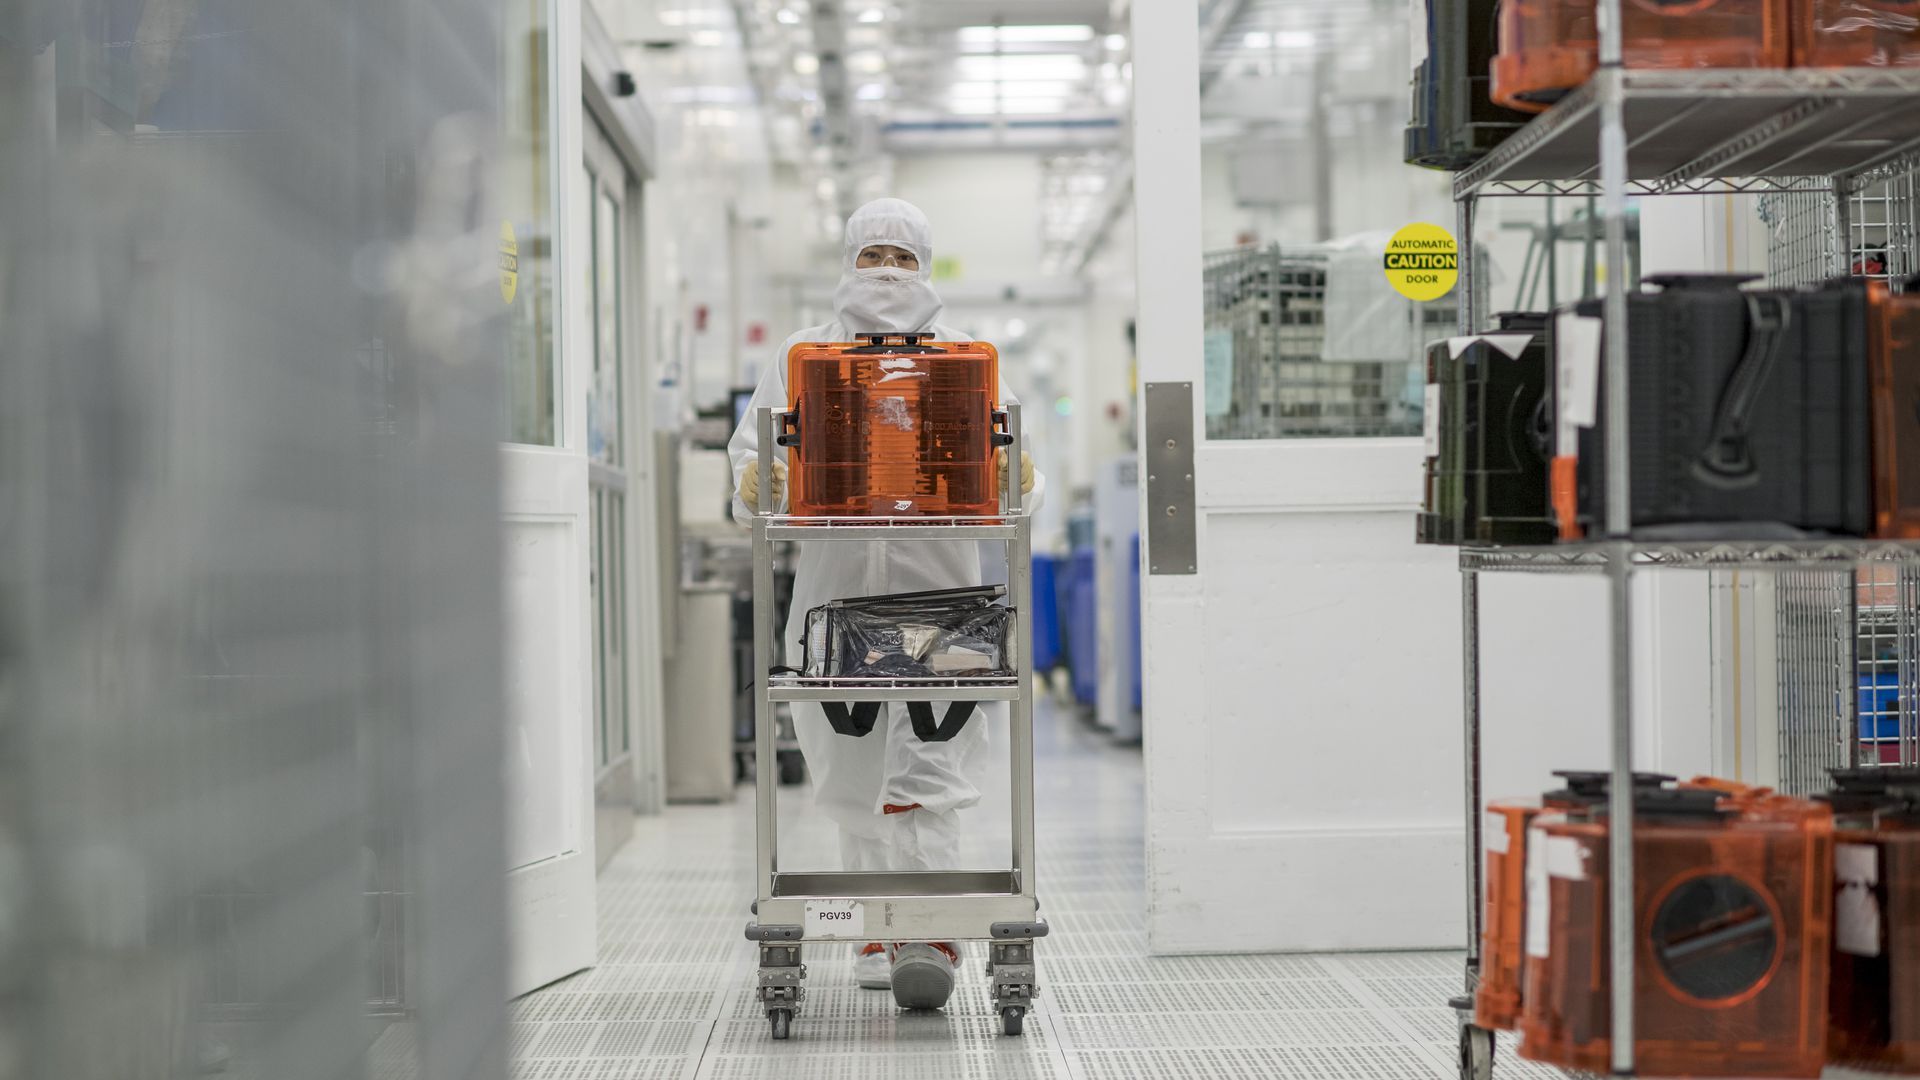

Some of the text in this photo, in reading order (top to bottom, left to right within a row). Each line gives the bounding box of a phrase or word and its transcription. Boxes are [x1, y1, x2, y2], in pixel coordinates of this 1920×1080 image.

[1391, 239, 1455, 249] AUTOMATIC
[1387, 254, 1457, 268] CAUTION
[1406, 274, 1438, 284] DOOR
[819, 911, 852, 921] PGV39
